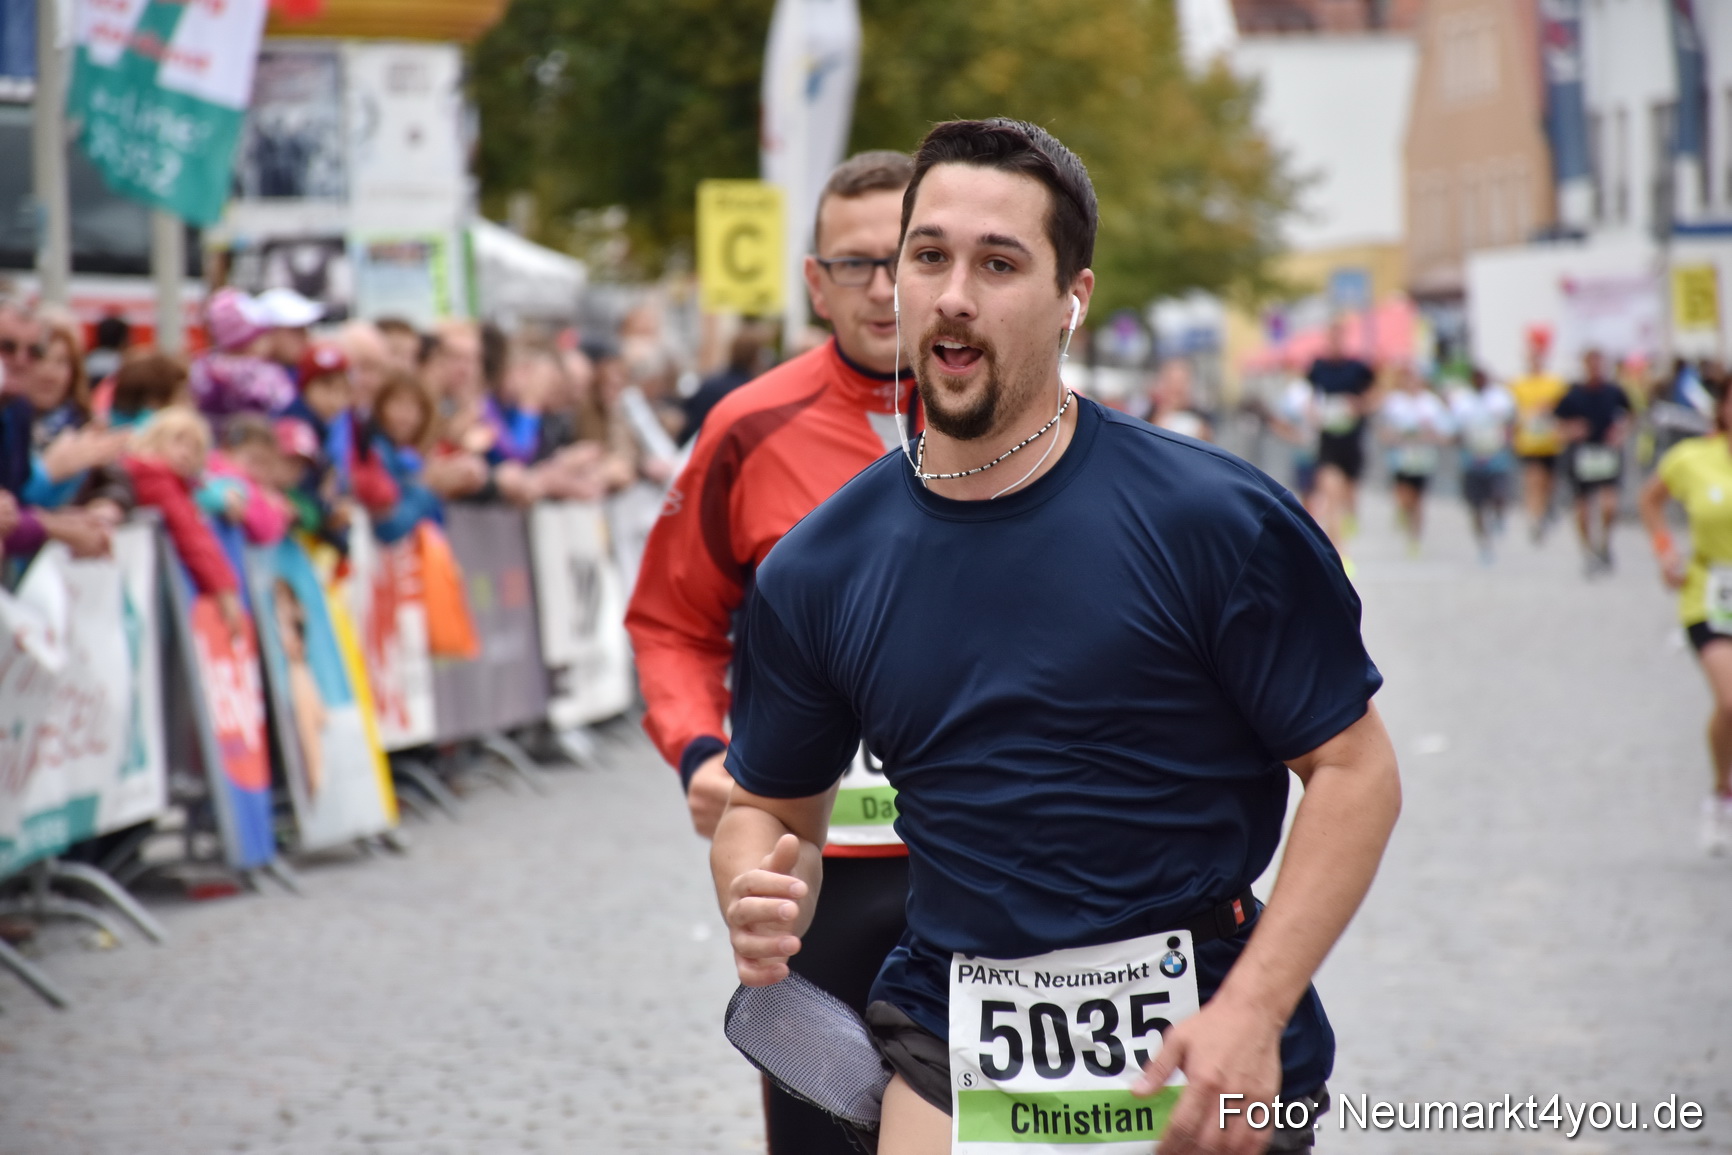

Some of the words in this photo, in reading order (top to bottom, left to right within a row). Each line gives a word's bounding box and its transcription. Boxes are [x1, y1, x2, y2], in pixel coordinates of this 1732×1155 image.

[721, 222, 766, 284] C
[862, 796, 893, 820] Da
[958, 964, 1028, 988] PARTL
[1034, 963, 1150, 989] Neumarkt
[978, 991, 1176, 1082] 5035
[963, 1072, 973, 1088] S
[1011, 1102, 1153, 1135] Christian
